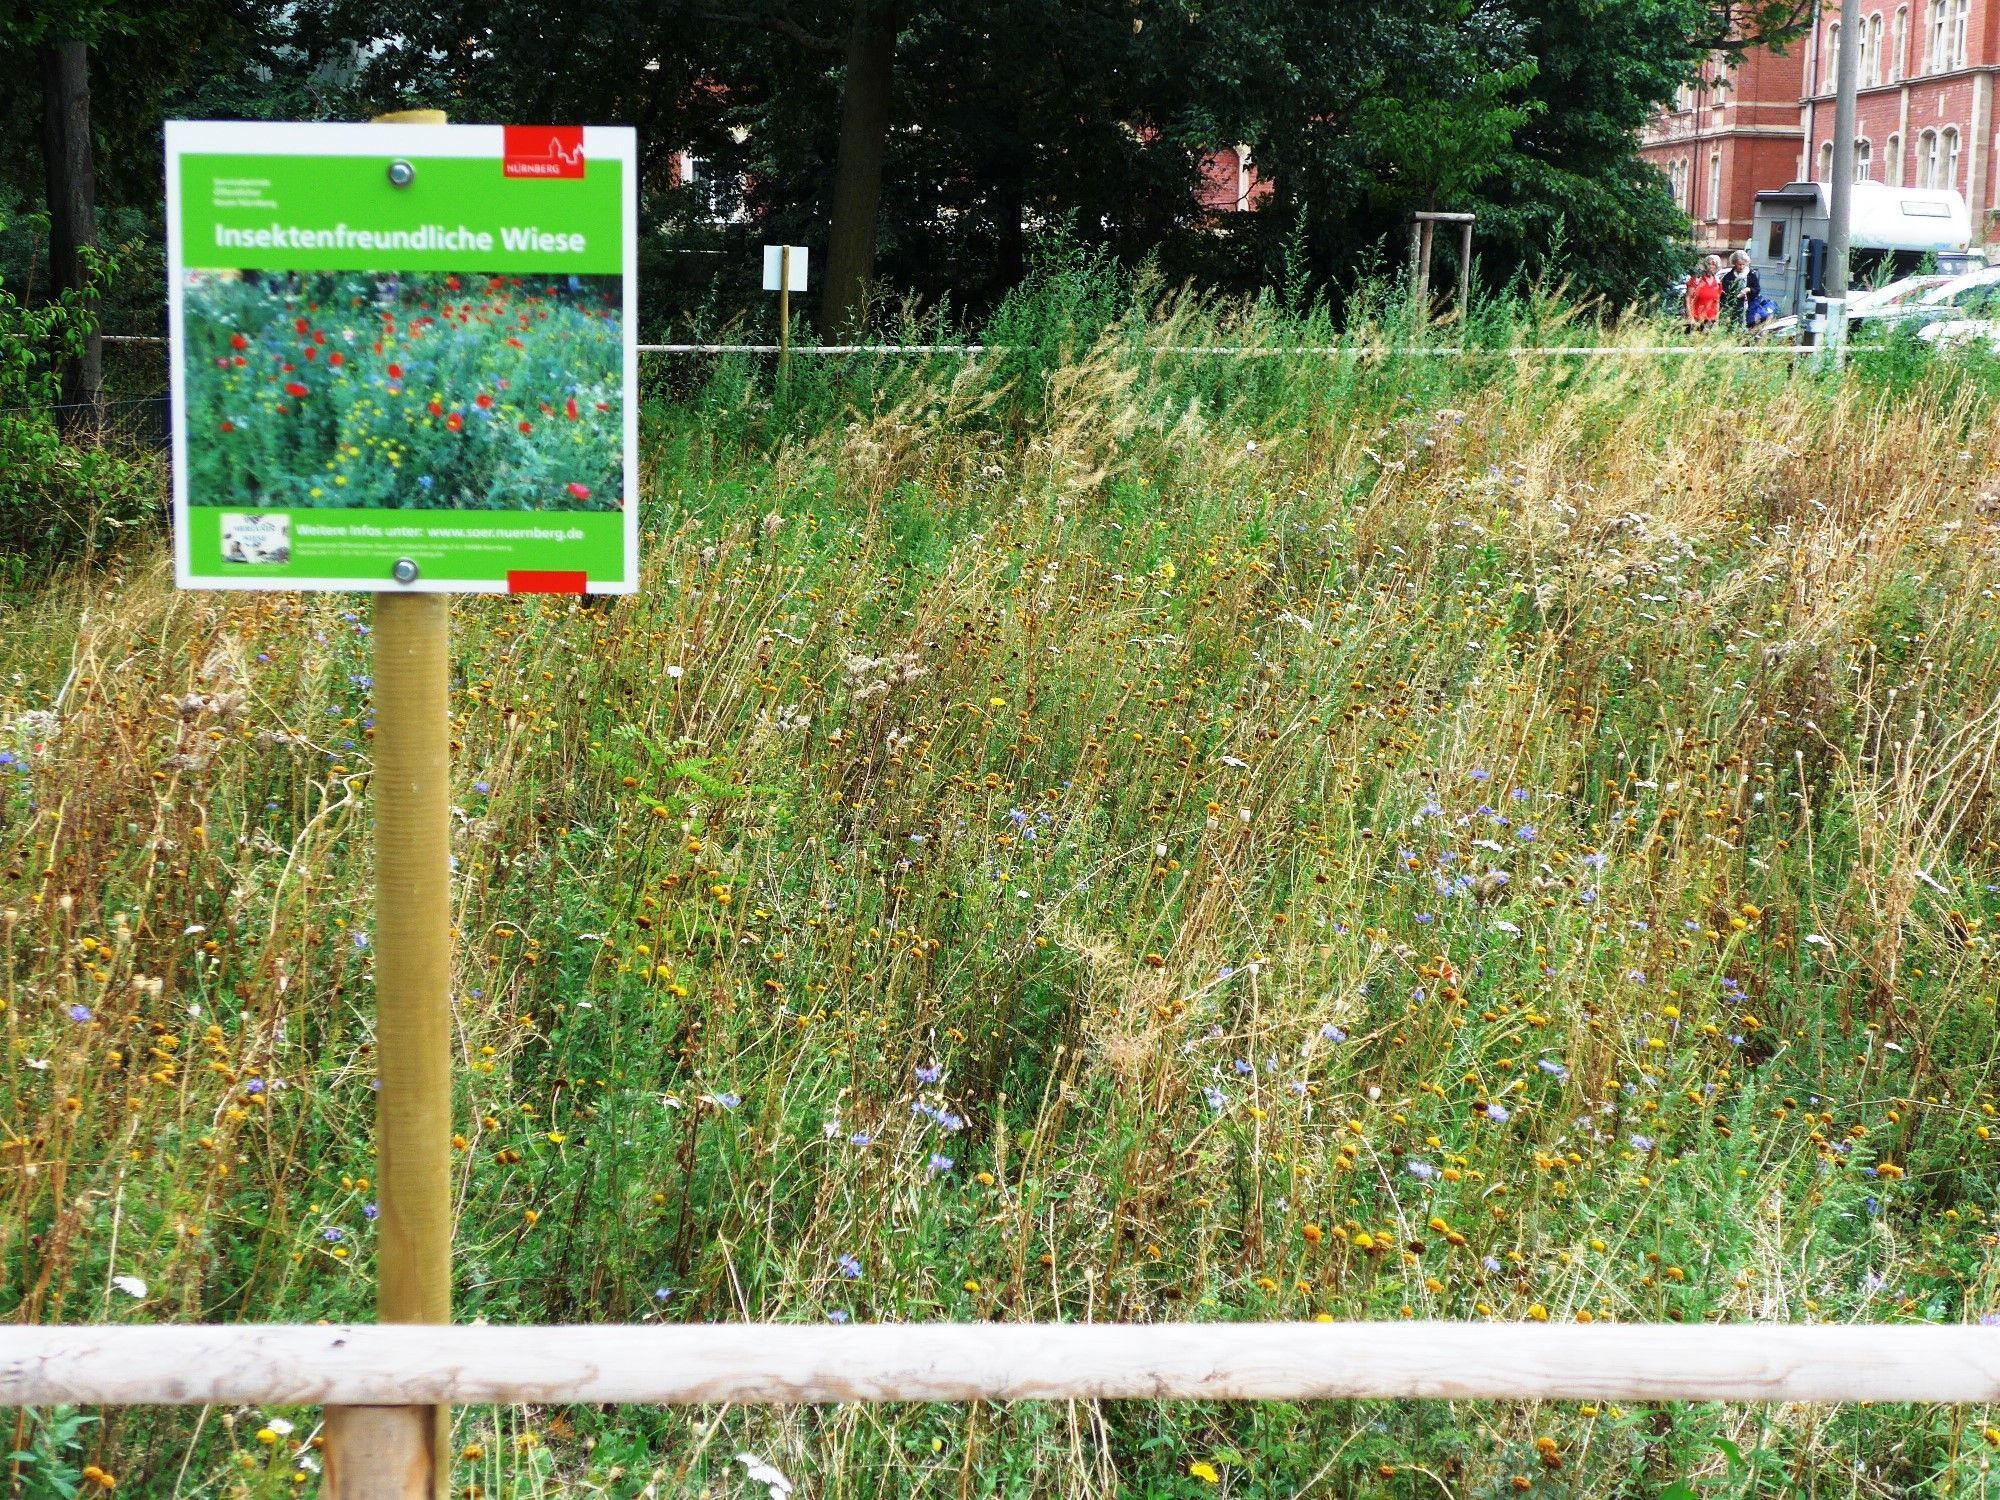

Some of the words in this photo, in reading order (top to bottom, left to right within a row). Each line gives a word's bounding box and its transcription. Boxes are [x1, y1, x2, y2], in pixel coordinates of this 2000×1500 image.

[507, 162, 560, 174] NÜRNBERG
[215, 223, 493, 252] Insektenfreundliche
[501, 227, 586, 253] Wiese
[296, 523, 346, 536] Weitere
[350, 524, 382, 537] Infos
[385, 526, 422, 538] unter:
[427, 526, 584, 542] www.soer.nuernberg.de
